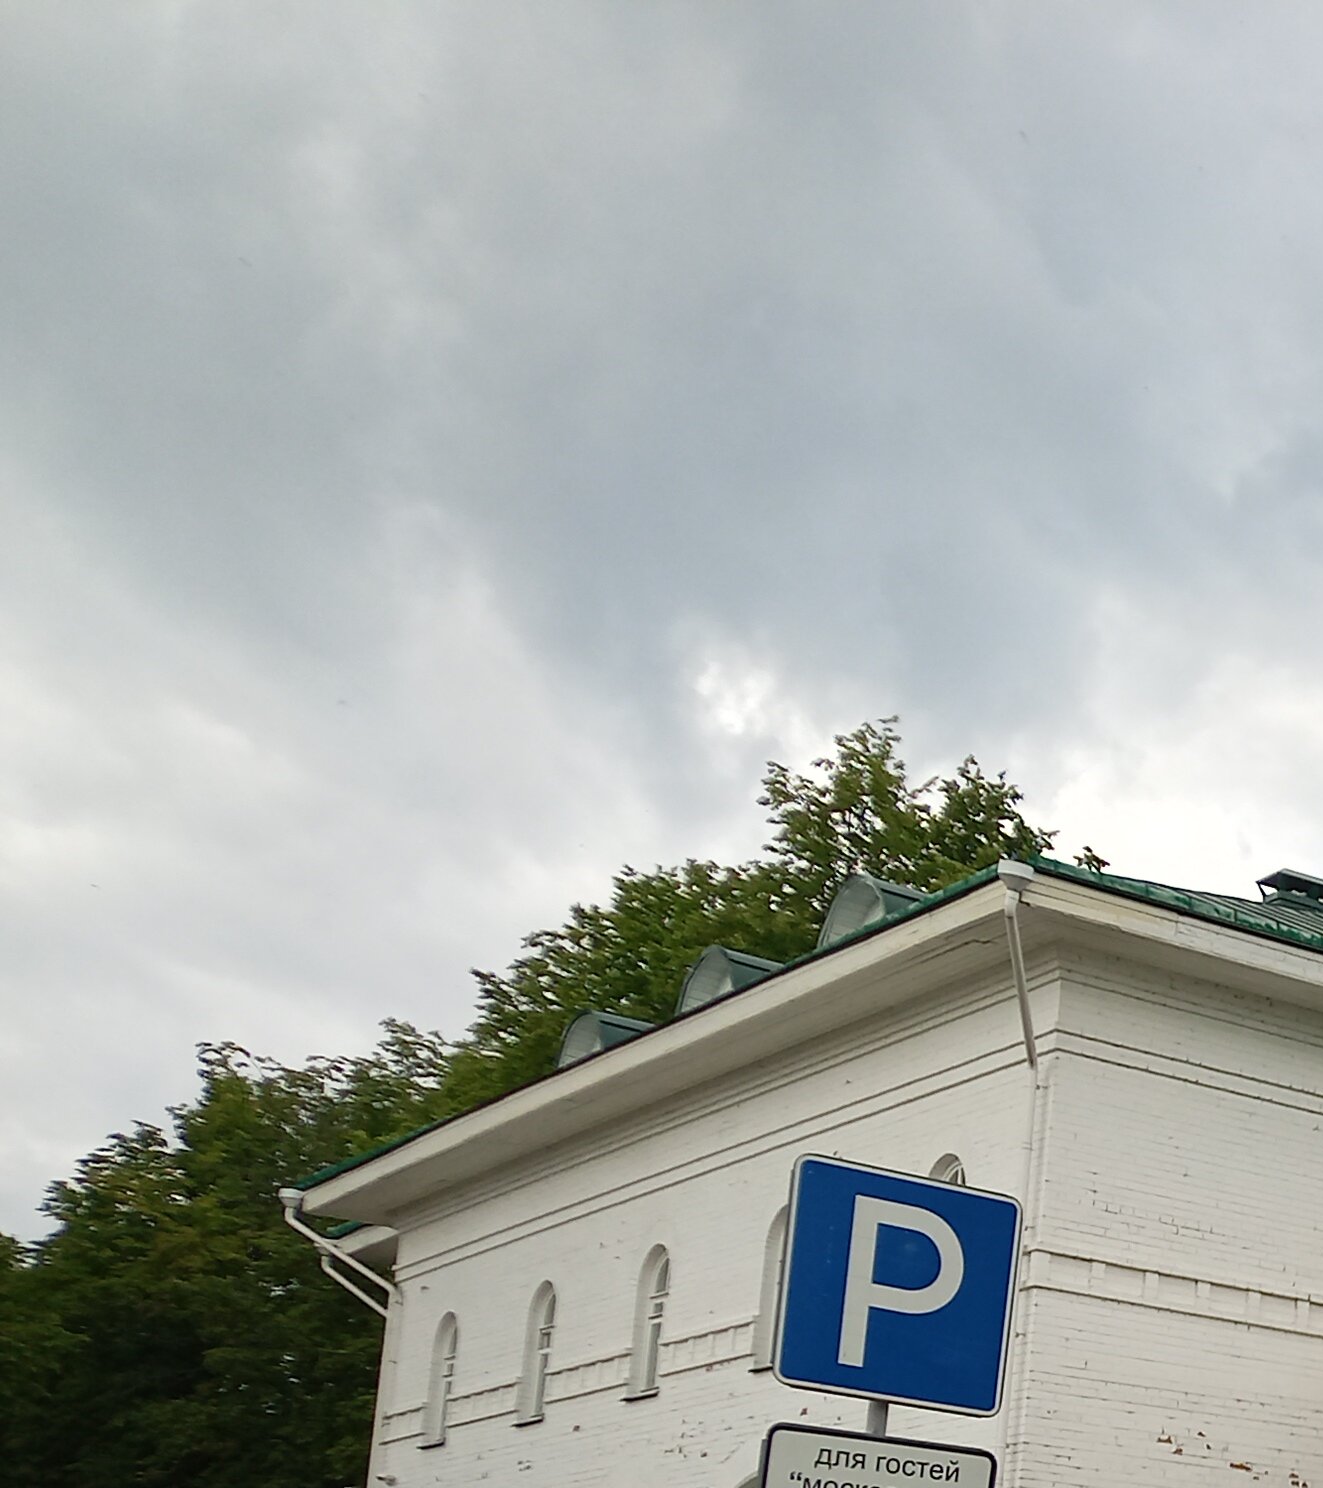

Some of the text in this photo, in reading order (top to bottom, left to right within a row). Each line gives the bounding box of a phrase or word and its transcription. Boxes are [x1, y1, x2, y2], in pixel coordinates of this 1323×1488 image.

[836, 1194, 964, 1368] P
[814, 1448, 960, 1483] для гостей
